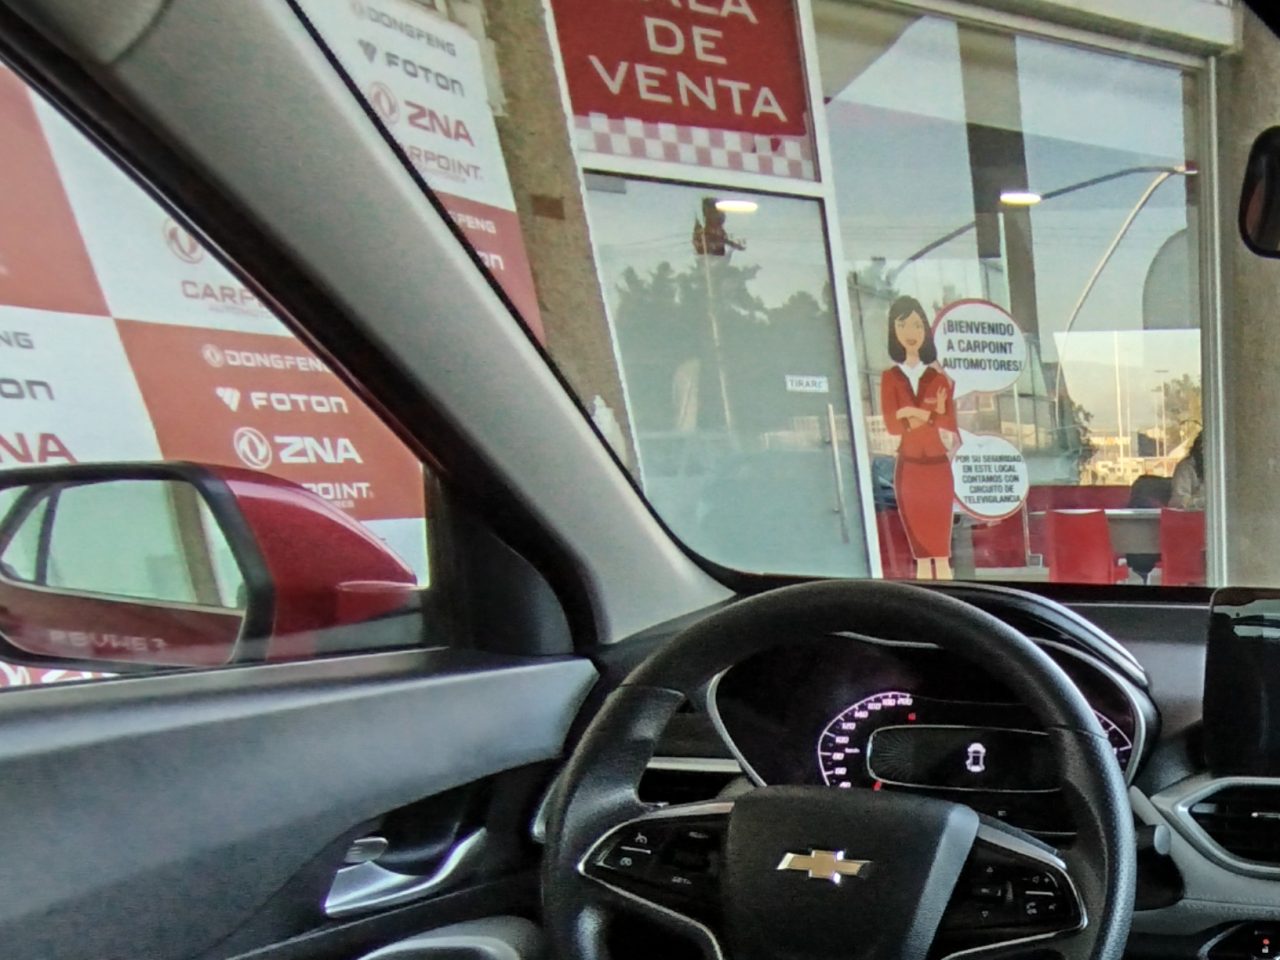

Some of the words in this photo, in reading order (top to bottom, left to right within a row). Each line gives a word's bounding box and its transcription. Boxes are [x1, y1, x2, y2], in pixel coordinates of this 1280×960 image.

[644, 16, 728, 65] DE
[385, 52, 465, 98] FOTON
[587, 54, 788, 123] VENTA
[404, 100, 476, 148] ZNA
[402, 144, 481, 180] RPOINT
[181, 280, 262, 306] CARP
[947, 338, 955, 353] A
[957, 339, 1014, 355] CARPOINT
[223, 349, 332, 374] DONGFEN
[250, 391, 349, 414] FOTON
[0, 433, 79, 464] NA
[273, 435, 364, 464] ZNA
[962, 464, 973, 473] EN
[974, 464, 992, 473] ESTE
[994, 464, 1017, 473] LOCAL
[962, 474, 1003, 484] CONTAMOS
[1004, 474, 1020, 483] CON
[969, 485, 1004, 494] CIRCUITO
[1005, 485, 1015, 493] DE
